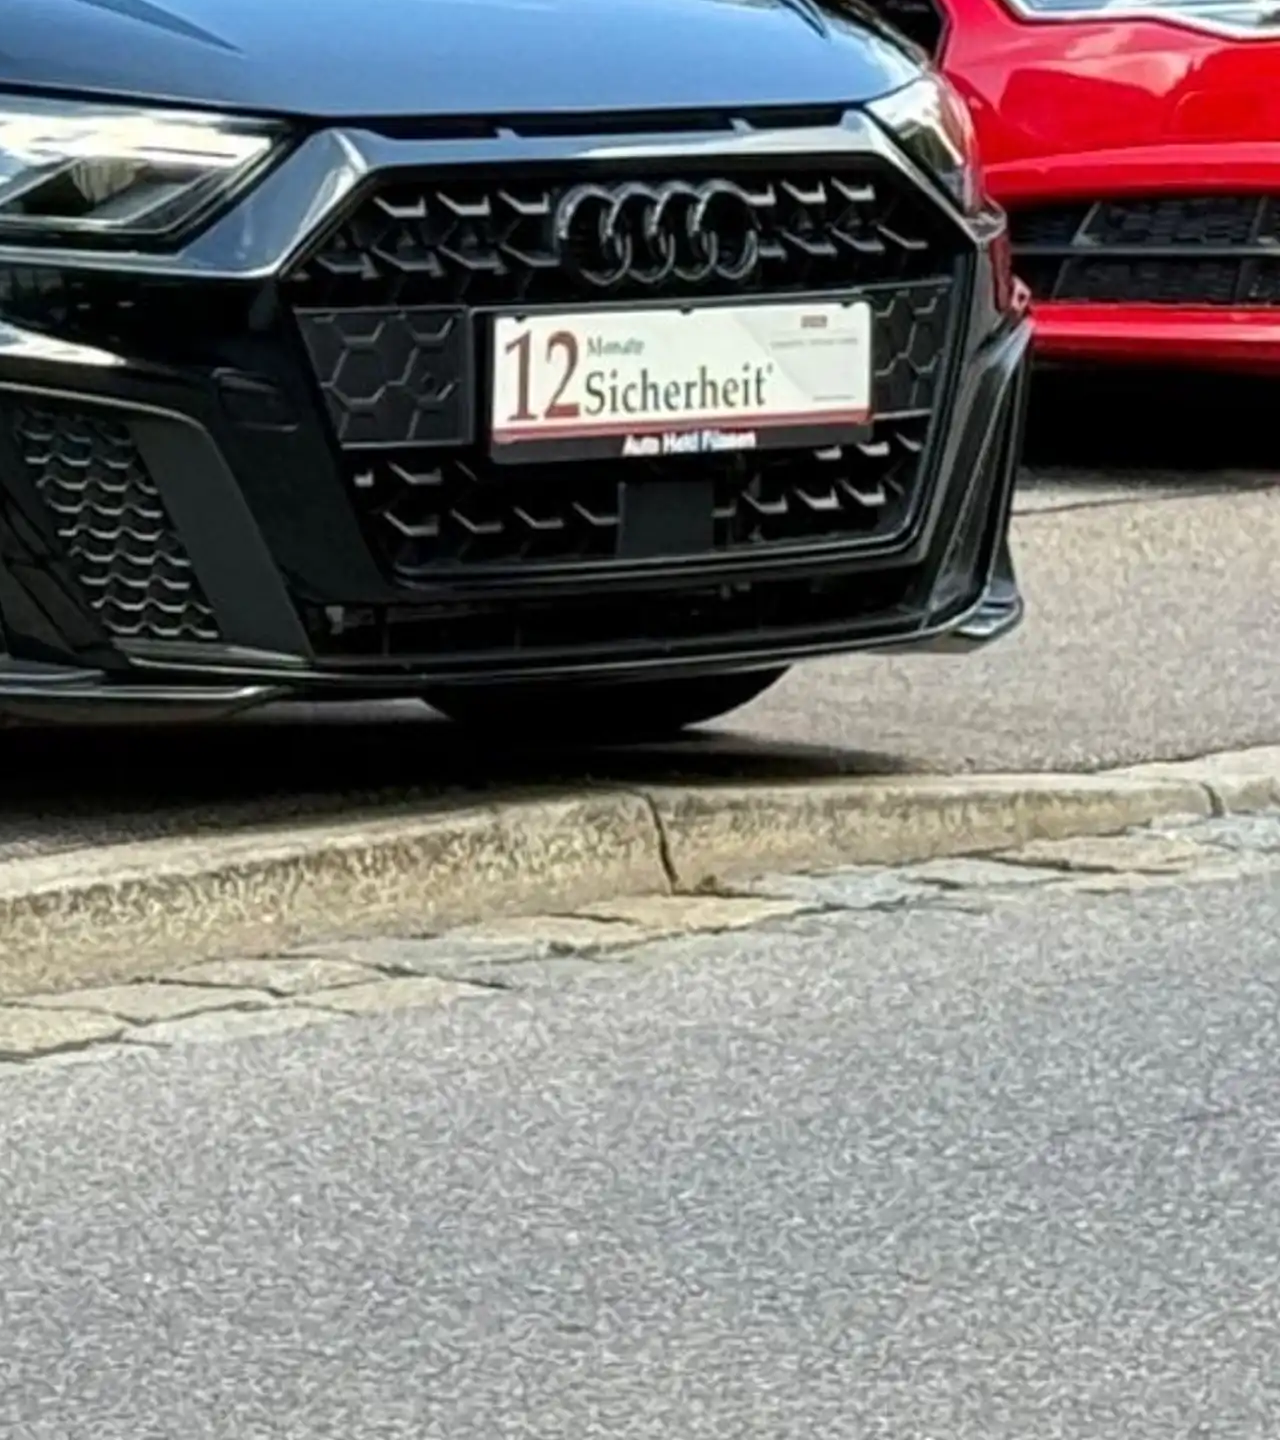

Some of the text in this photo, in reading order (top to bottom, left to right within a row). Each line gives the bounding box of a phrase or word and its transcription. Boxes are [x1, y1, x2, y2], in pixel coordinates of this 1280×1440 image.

[587, 336, 645, 357] Monate
[505, 329, 580, 422] 12
[622, 435, 660, 457] Auto
[663, 432, 699, 455] Held
